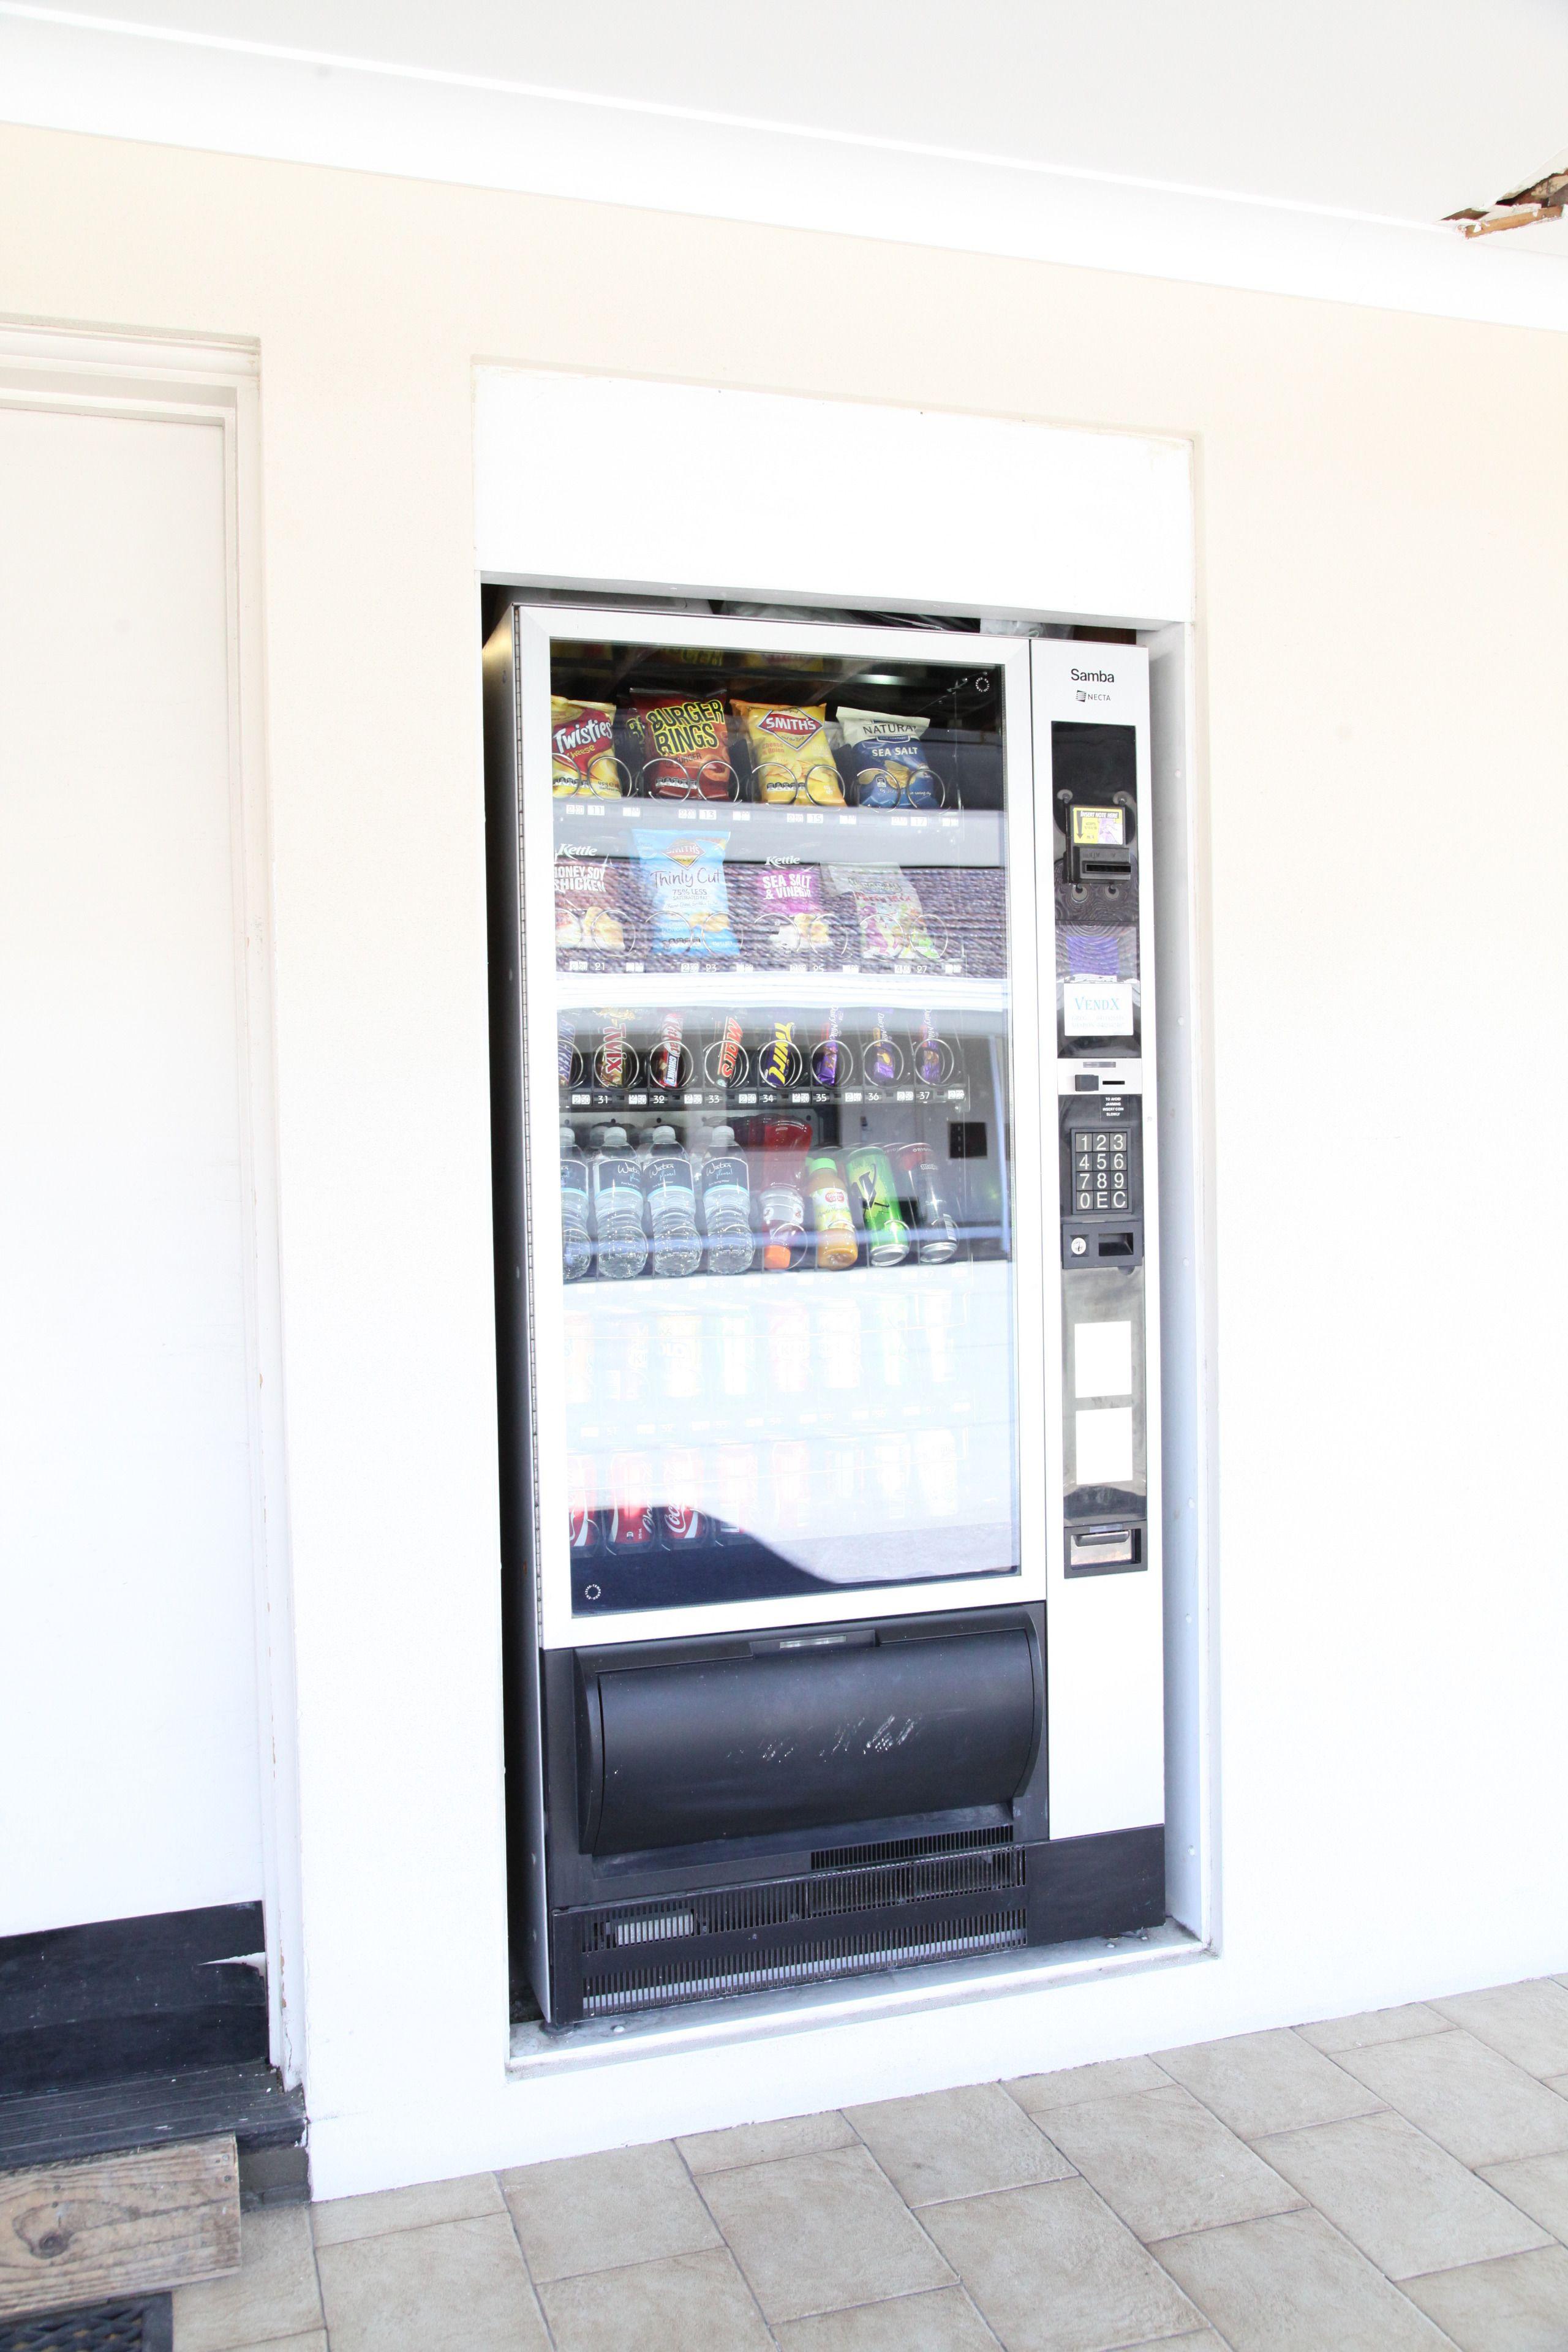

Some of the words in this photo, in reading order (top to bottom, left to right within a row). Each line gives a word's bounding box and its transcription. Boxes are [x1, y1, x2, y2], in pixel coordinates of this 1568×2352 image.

[1071, 669, 1115, 683] Samba
[646, 699, 725, 733] BURGER
[766, 717, 816, 730] SMITH'S
[553, 719, 612, 753] Twisties
[654, 723, 720, 756] RINGS
[895, 747, 918, 755] SALT
[557, 843, 598, 859] Kettle
[764, 856, 801, 867] Kettle
[587, 867, 605, 881] SOY
[650, 869, 694, 888] Thinly
[697, 867, 723, 884] Cut
[762, 874, 787, 889] SEA
[788, 873, 812, 889] SALT
[763, 889, 775, 900] &
[595, 962, 605, 971] 21
[706, 964, 717, 973] 23
[916, 965, 927, 974] 27
[721, 1017, 744, 1079] Mars
[769, 1022, 795, 1085] Twirl
[598, 1095, 608, 1104] 31
[653, 1095, 665, 1104] 32
[708, 1095, 720, 1103] 33
[763, 1095, 774, 1103] 34
[815, 1093, 827, 1102] 35
[868, 1093, 880, 1101] 36
[1081, 1135, 1088, 1150] 1
[1096, 1134, 1107, 1150] 2
[1114, 1134, 1123, 1150] 3
[1079, 1154, 1090, 1170] 4
[1096, 1153, 1107, 1169] 5
[1114, 1153, 1124, 1169] 6
[649, 1163, 674, 1178] Water
[706, 1162, 732, 1177] Water
[1079, 1174, 1090, 1189] 7
[1096, 1172, 1107, 1189] 8
[1114, 1172, 1124, 1188] 9
[1097, 1191, 1108, 1208] E
[1114, 1191, 1126, 1208] C
